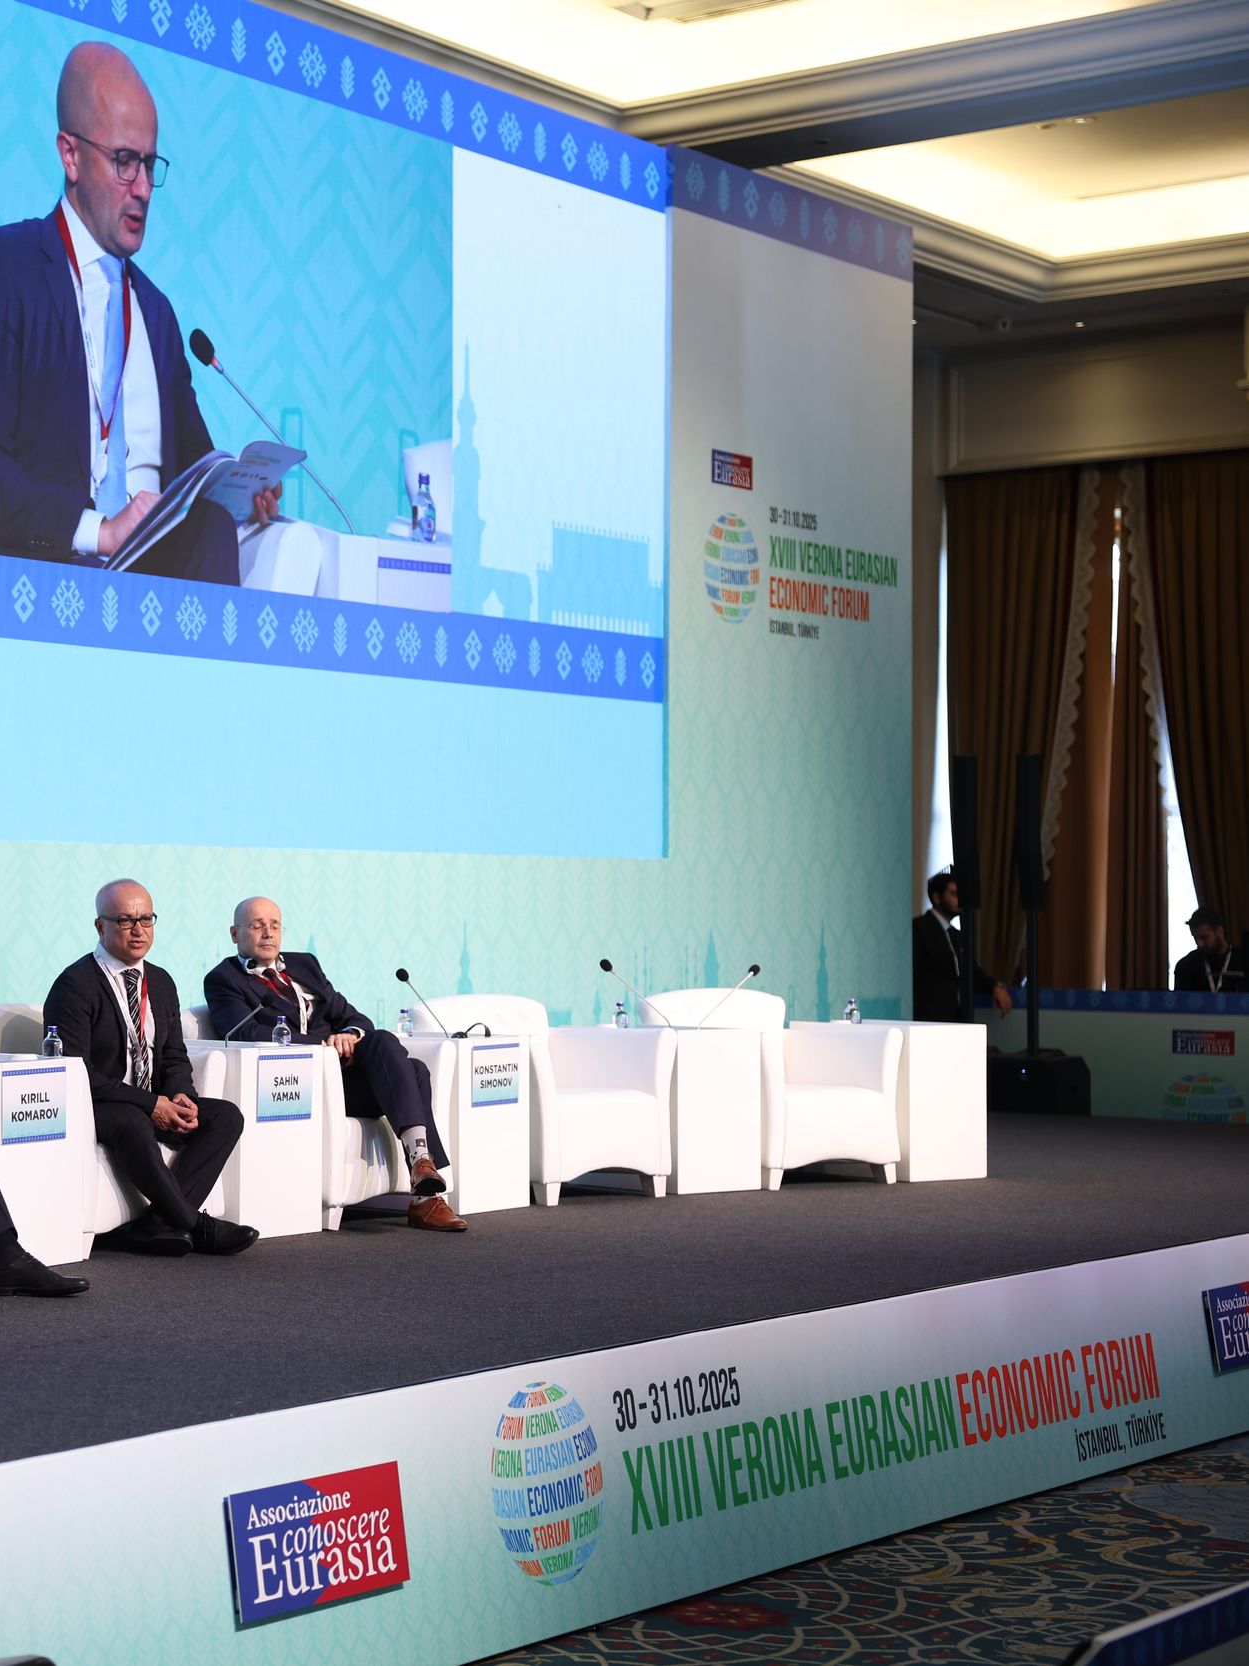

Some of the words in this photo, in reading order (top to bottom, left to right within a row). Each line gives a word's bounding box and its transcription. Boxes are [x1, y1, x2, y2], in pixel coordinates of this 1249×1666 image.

[769, 535, 797, 571] XVIII
[799, 540, 843, 579] VERONA
[846, 549, 898, 588] EURASIAN
[769, 576, 829, 616] ECONOMIC
[831, 585, 870, 622] FORUM
[474, 1062, 519, 1075] KONSTANTIN
[480, 1077, 513, 1089] SIMONOV
[11, 1107, 59, 1123] KOMAROV
[20, 1092, 50, 1105] KIRILL
[271, 1091, 301, 1102] YAMAN
[525, 1410, 560, 1439] VERONA
[622, 1434, 704, 1535] XVIII
[702, 1407, 827, 1511] VERONA
[825, 1376, 959, 1480] EURASIAN
[955, 1348, 1082, 1447] ECONOMIC
[1080, 1332, 1161, 1413] FORUM
[1074, 1419, 1127, 1462] İSTANBUL,
[1125, 1409, 1167, 1448] TÜRKİYE
[525, 1438, 576, 1477] EURASIAN
[247, 1490, 351, 1530] Associazione
[527, 1473, 585, 1517] ECONOMIC
[282, 1507, 390, 1557] conoscere
[533, 1518, 571, 1551] FORUM
[248, 1532, 397, 1605] Eurasia
[541, 1550, 574, 1575] VERONA
